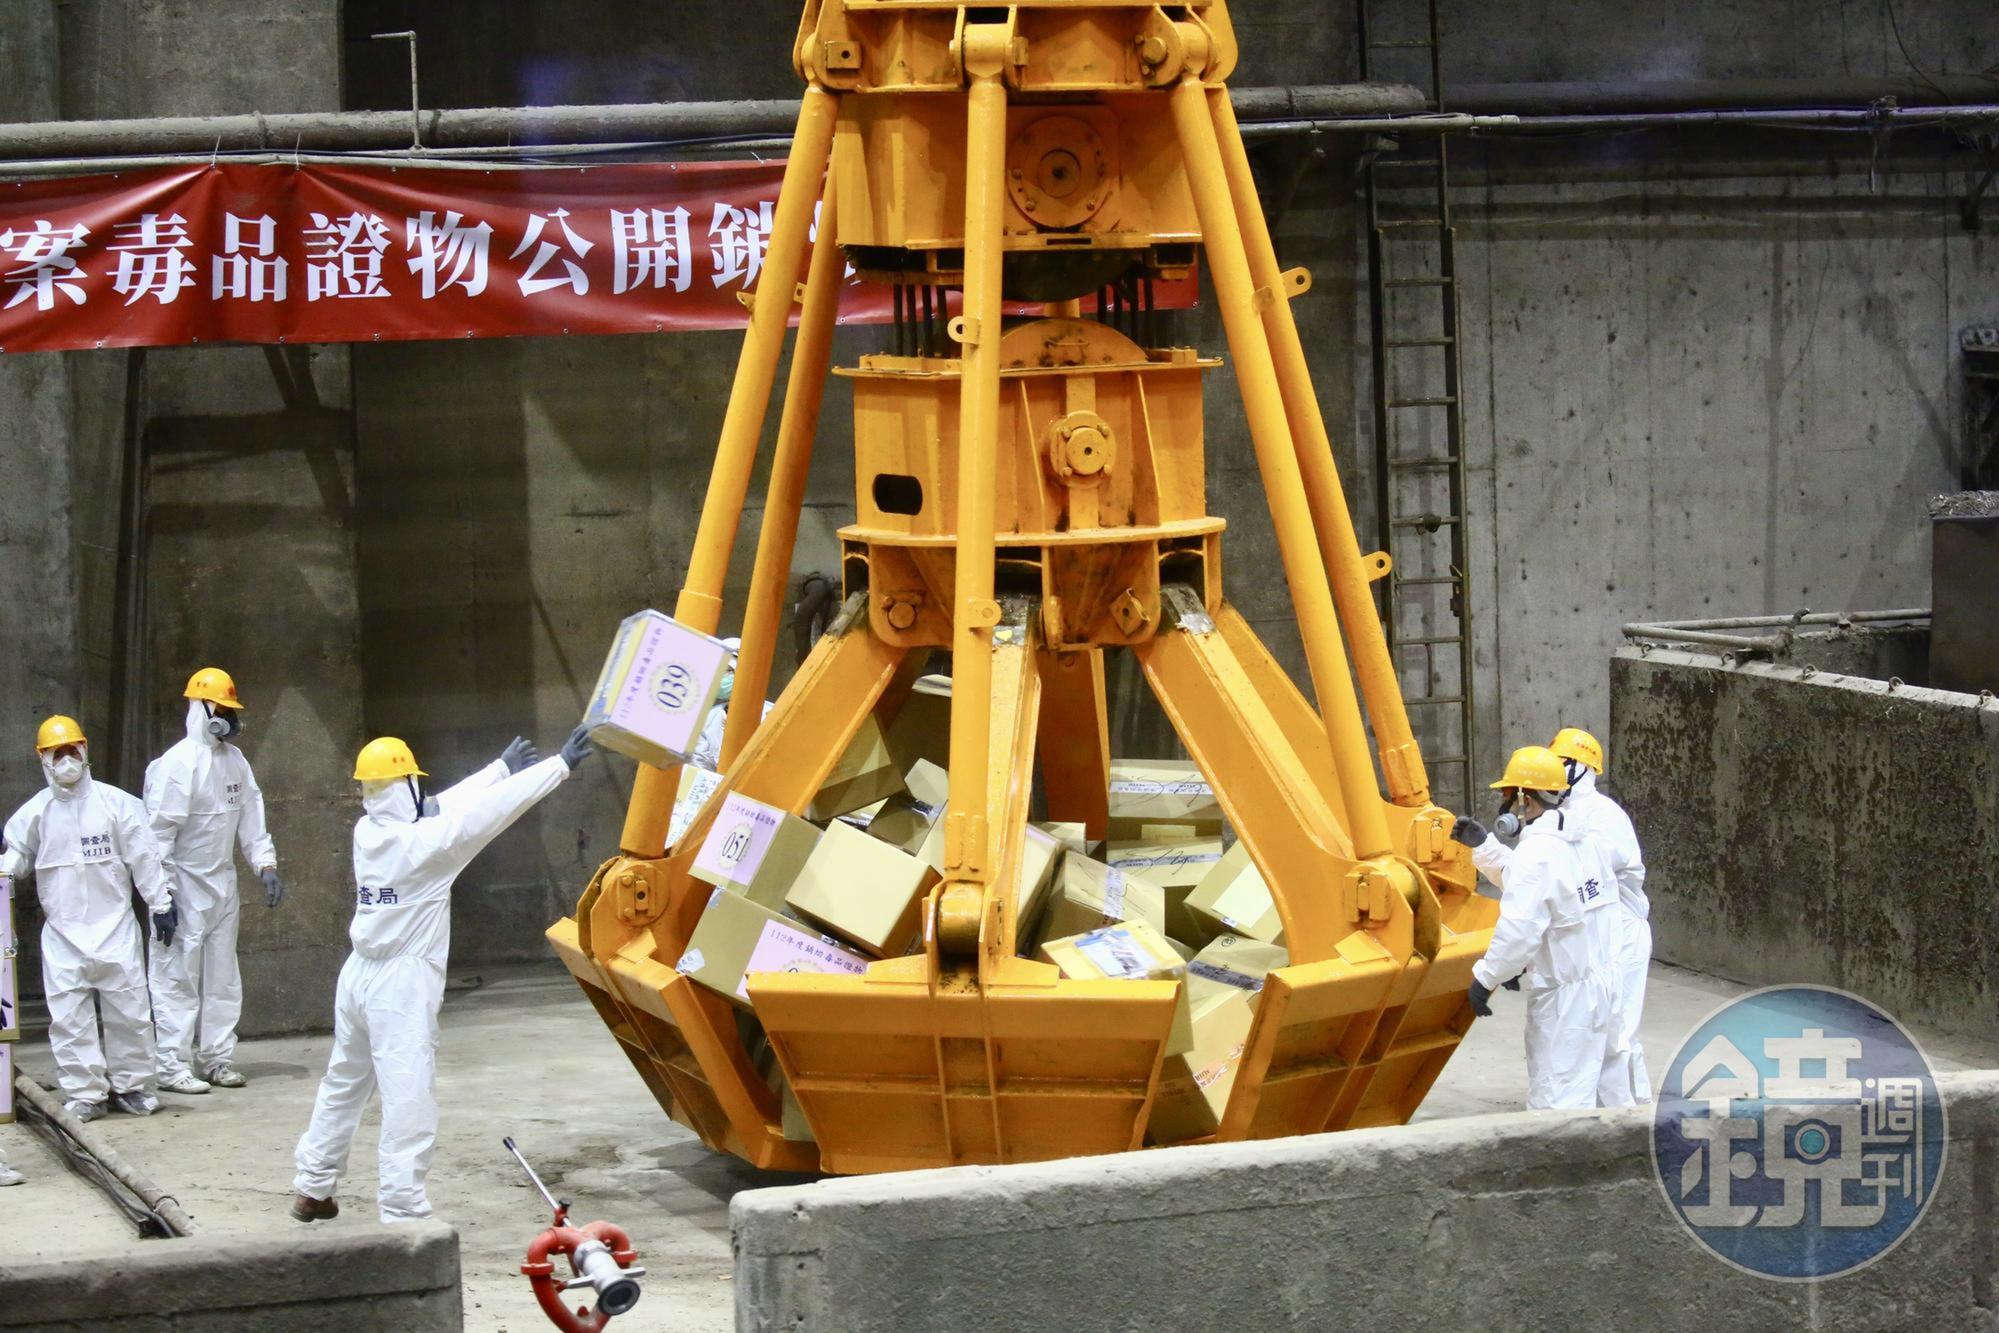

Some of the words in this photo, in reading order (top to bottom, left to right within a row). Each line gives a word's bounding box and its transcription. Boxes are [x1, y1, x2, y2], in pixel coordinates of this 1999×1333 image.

[0, 200, 862, 312] 案毒品證物公開銷
[656, 664, 692, 709] 039
[722, 831, 750, 861] 051
[359, 885, 398, 905] 查局
